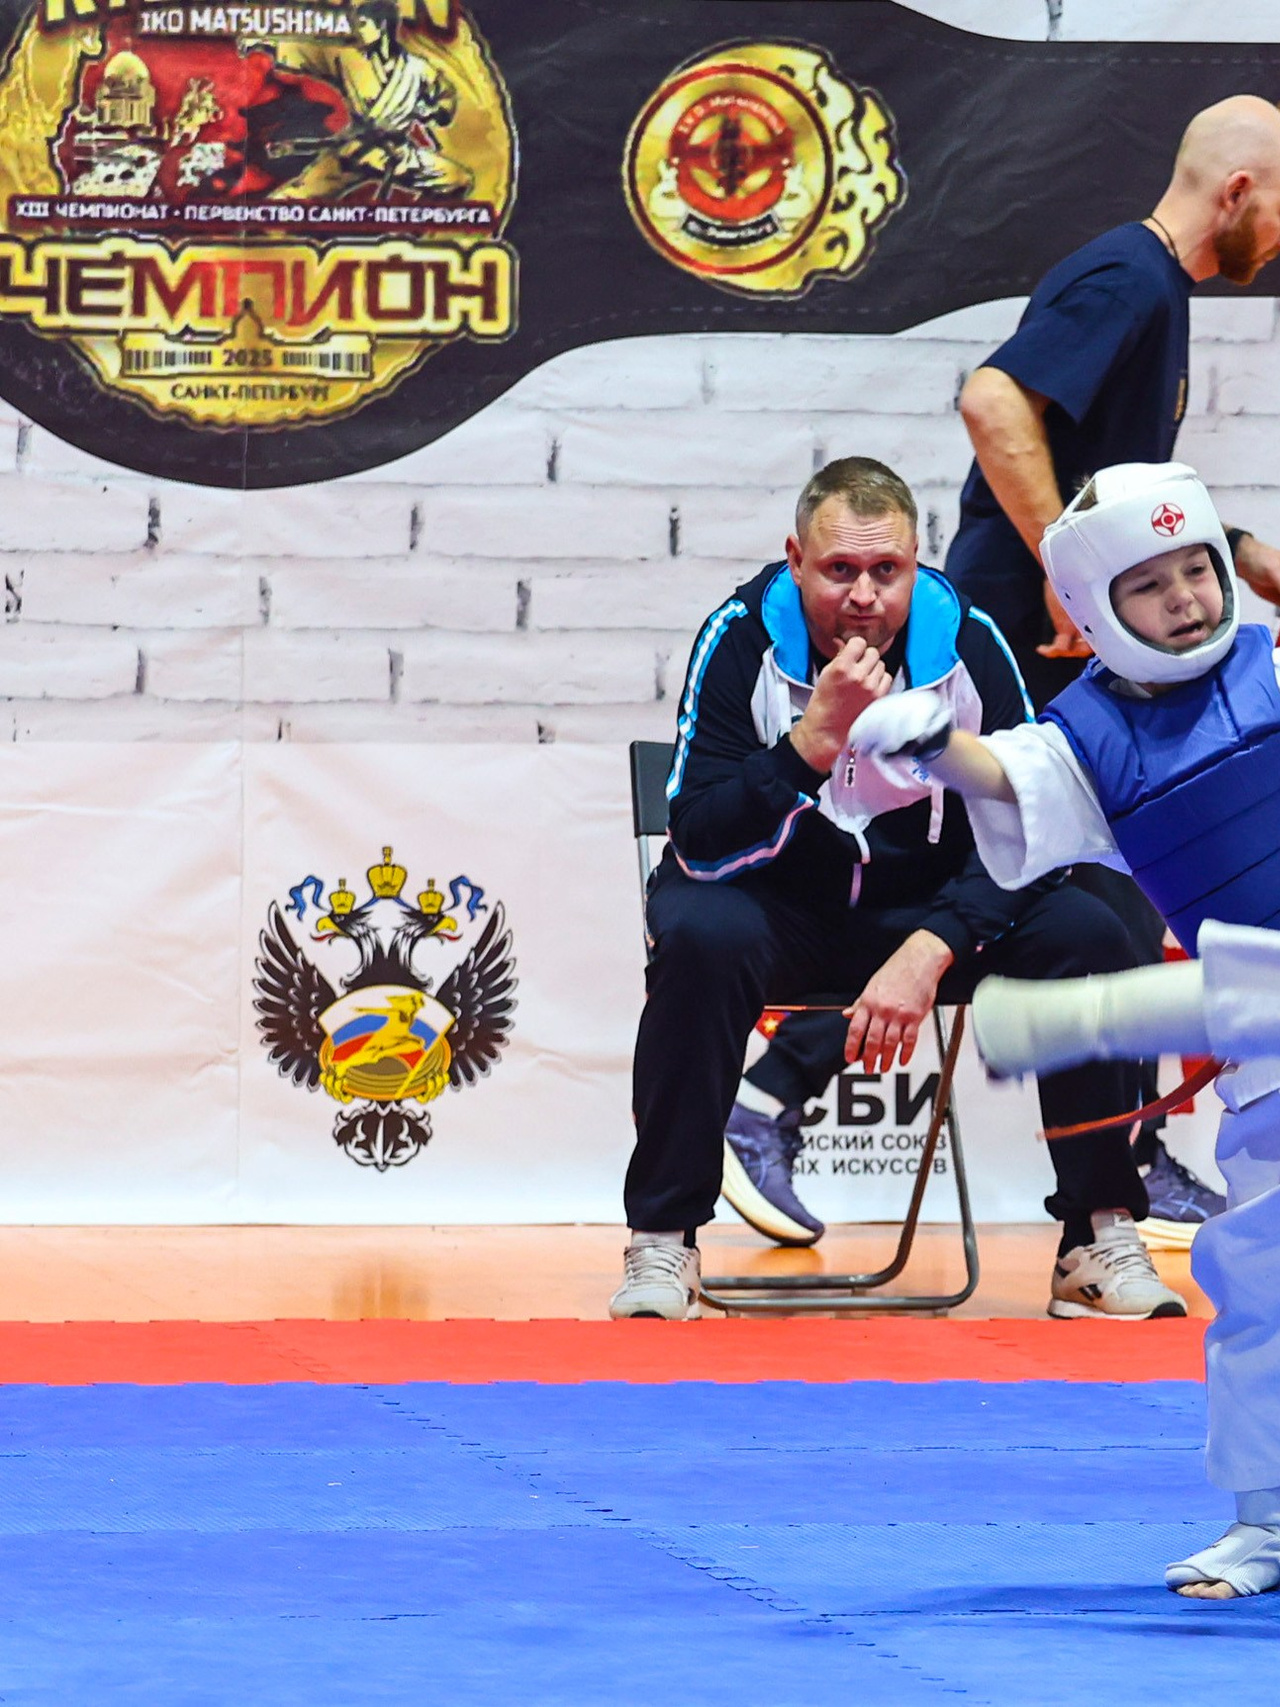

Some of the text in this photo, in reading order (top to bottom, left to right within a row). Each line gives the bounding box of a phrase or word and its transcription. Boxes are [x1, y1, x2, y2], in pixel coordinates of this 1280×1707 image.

[140, 12, 184, 32] IKO
[189, 8, 352, 36] MATSUSHIMA
[55, 202, 168, 219] ЧЕМПИОНАТ
[184, 204, 305, 222] ПЕРВЕНСТВО
[307, 205, 492, 224] САНКТ-ПЕТЕРБУРГА
[0, 254, 499, 327] ЧЕМПИОН
[222, 349, 273, 367] 2025
[801, 1130, 874, 1151] ЙСКИЙ
[833, 1158, 947, 1176] ИСКУССВ
